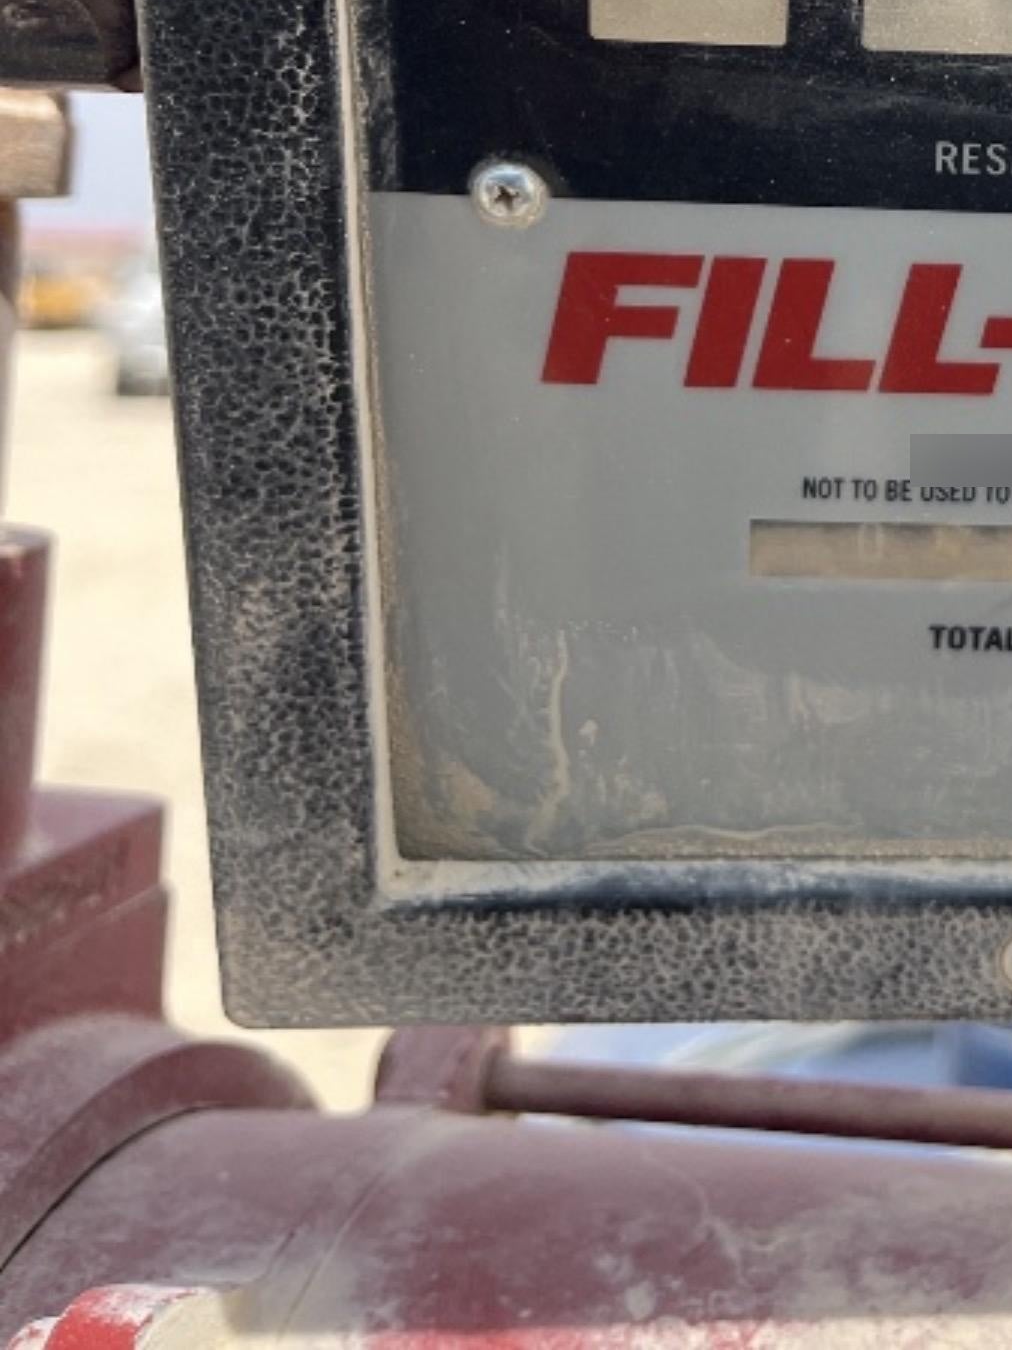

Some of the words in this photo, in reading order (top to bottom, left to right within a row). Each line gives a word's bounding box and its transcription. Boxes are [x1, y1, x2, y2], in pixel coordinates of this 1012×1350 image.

[802, 476, 845, 500] NOT
[852, 478, 878, 501] TO
[885, 479, 912, 502] BE
[920, 486, 977, 503] USED
